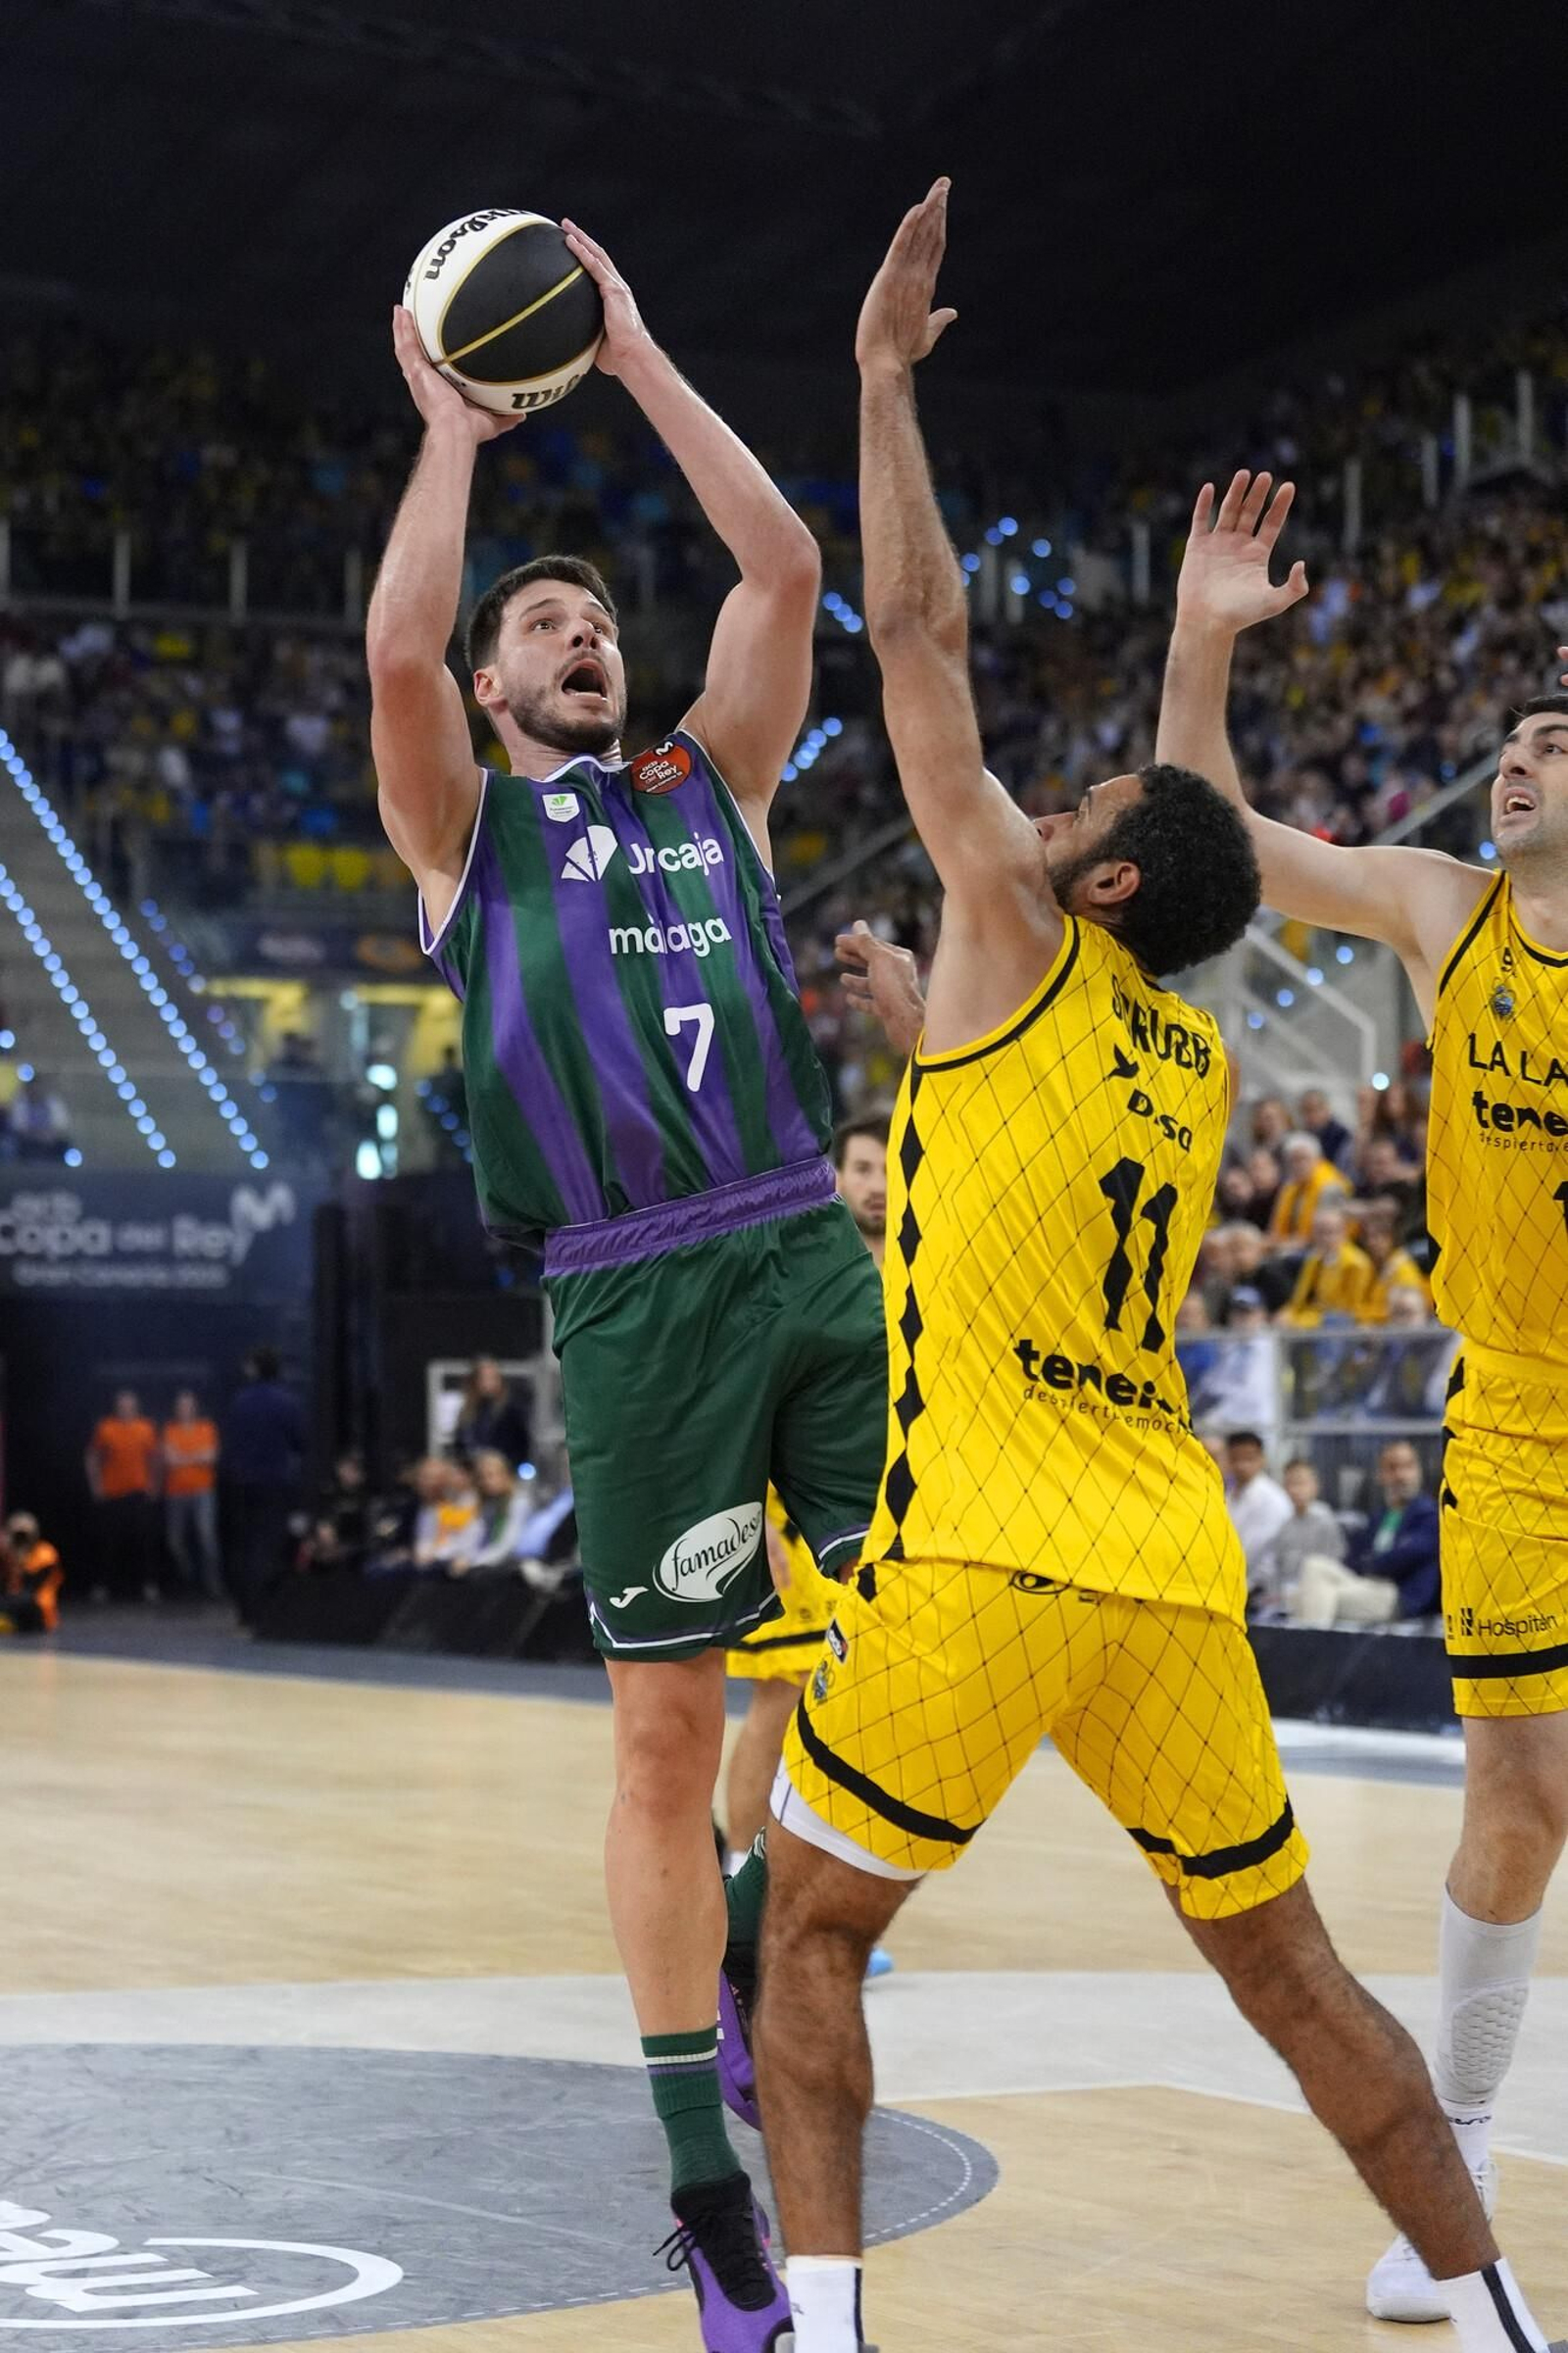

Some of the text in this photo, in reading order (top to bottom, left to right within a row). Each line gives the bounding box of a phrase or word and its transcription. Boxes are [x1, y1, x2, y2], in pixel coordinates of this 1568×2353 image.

[609, 912, 732, 957] máaga
[663, 1003, 715, 1092] 7
[1111, 973, 1211, 1079] SRUBB
[1469, 1033, 1511, 1076] LA
[1099, 1156, 1178, 1354] 11
